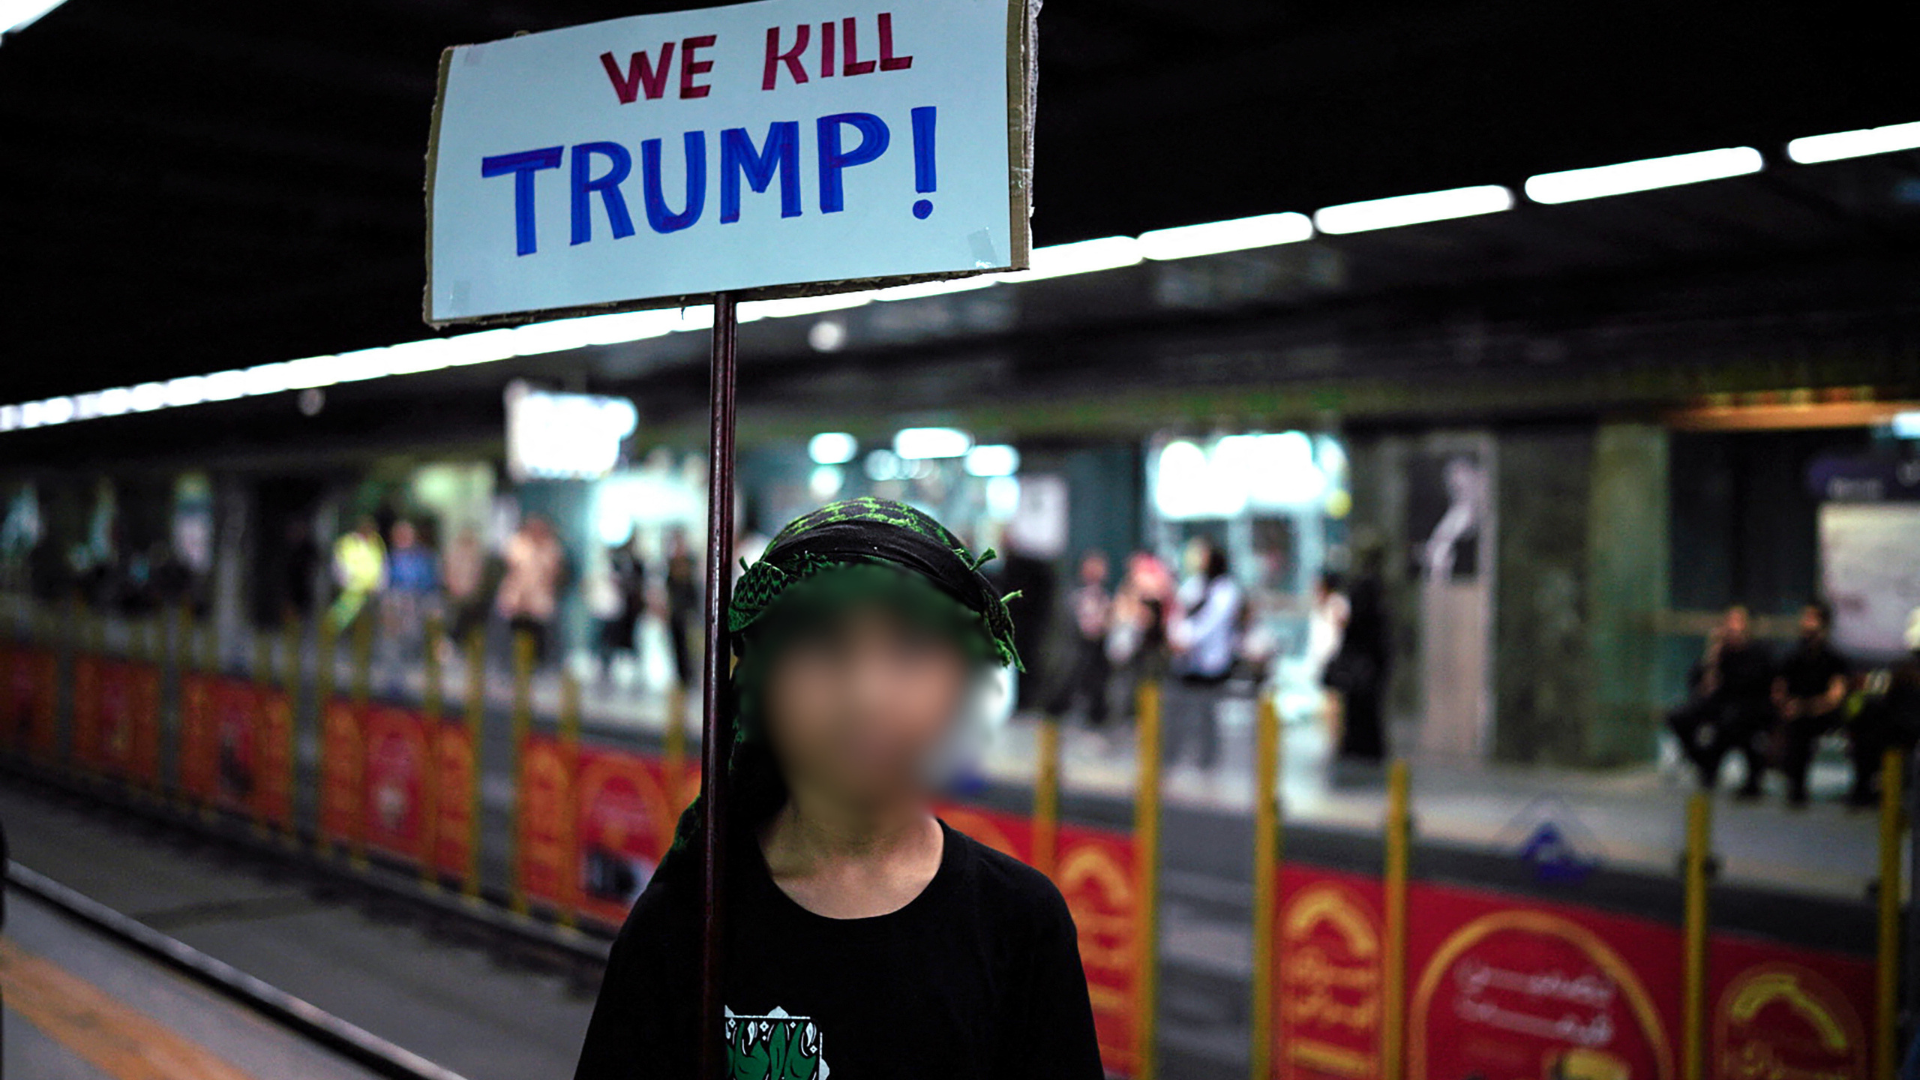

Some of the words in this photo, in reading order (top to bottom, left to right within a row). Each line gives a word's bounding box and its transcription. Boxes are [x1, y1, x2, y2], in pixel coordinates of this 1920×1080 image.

[600, 35, 718, 105] WE
[762, 12, 914, 91] KILL
[481, 106, 938, 256] TRUMP!
